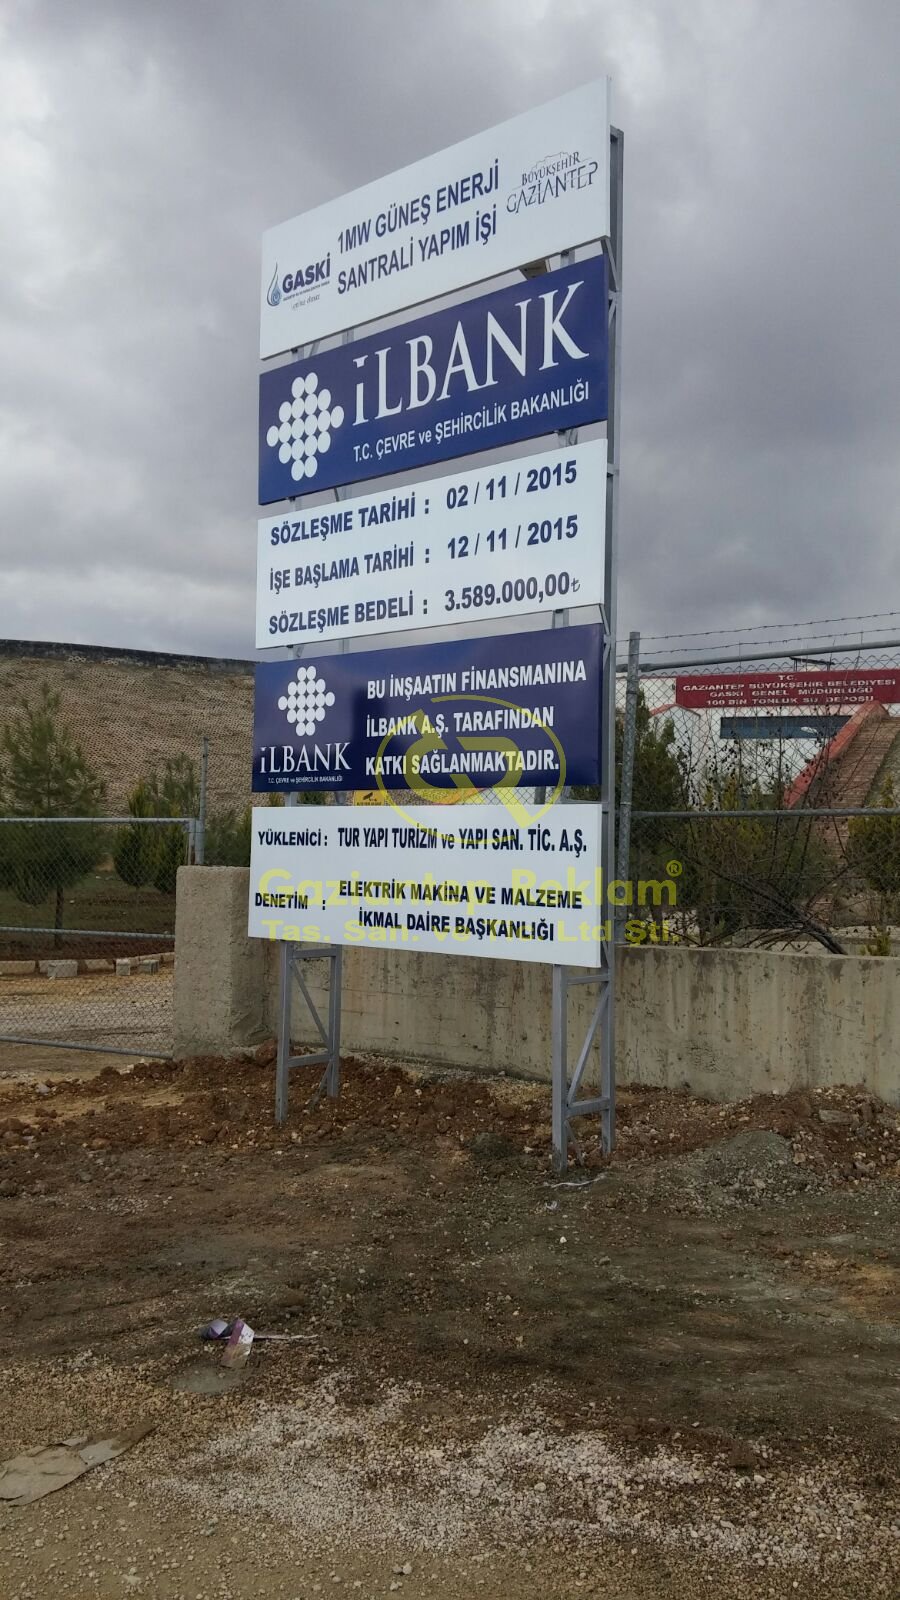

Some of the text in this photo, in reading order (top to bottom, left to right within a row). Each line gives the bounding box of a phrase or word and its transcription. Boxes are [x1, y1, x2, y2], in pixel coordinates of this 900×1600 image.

[337, 158, 499, 254] 1MW GÜNEŞ ENERJİ
[337, 236, 414, 295] SANTRALİ
[418, 220, 470, 263] YAPIM
[475, 204, 497, 245] İŞİ
[282, 252, 331, 293] GASKİ
[353, 377, 589, 463] T.C. ÇEVRE ve ŞEHİRCİLİK BAKANLIĞI
[270, 510, 353, 546] SÖZLEŞME
[359, 491, 416, 528] TARİHİ
[269, 567, 290, 594] İŞE
[294, 558, 359, 588] BAŞLAMA
[364, 541, 414, 573] TARİHİ
[268, 604, 349, 635] SÖZLEŞME
[354, 590, 414, 623] BEDELİ
[367, 659, 587, 701] BU İNŞAATIN FİNANSMANINA
[751, 689, 790, 697] GENEL
[366, 706, 554, 739] İLBANK A.Ş. TARAFINDAN
[365, 749, 560, 776] KATKI SAĞLANMAKTADIR.
[337, 827, 360, 848] TUR
[363, 827, 388, 848] YAPI
[391, 823, 438, 850] TURİZM
[441, 832, 455, 850] ve
[459, 827, 488, 851] YAPI
[491, 827, 524, 852] SAN.
[528, 823, 556, 852] TİC.
[559, 828, 587, 858] A.Ş.
[254, 891, 308, 910] DENETİM
[339, 878, 582, 909] ELEKTRİK MAKİNA VE MALZEME
[358, 906, 554, 942] İKMAL DAİRE BAŞKANLIĞI
